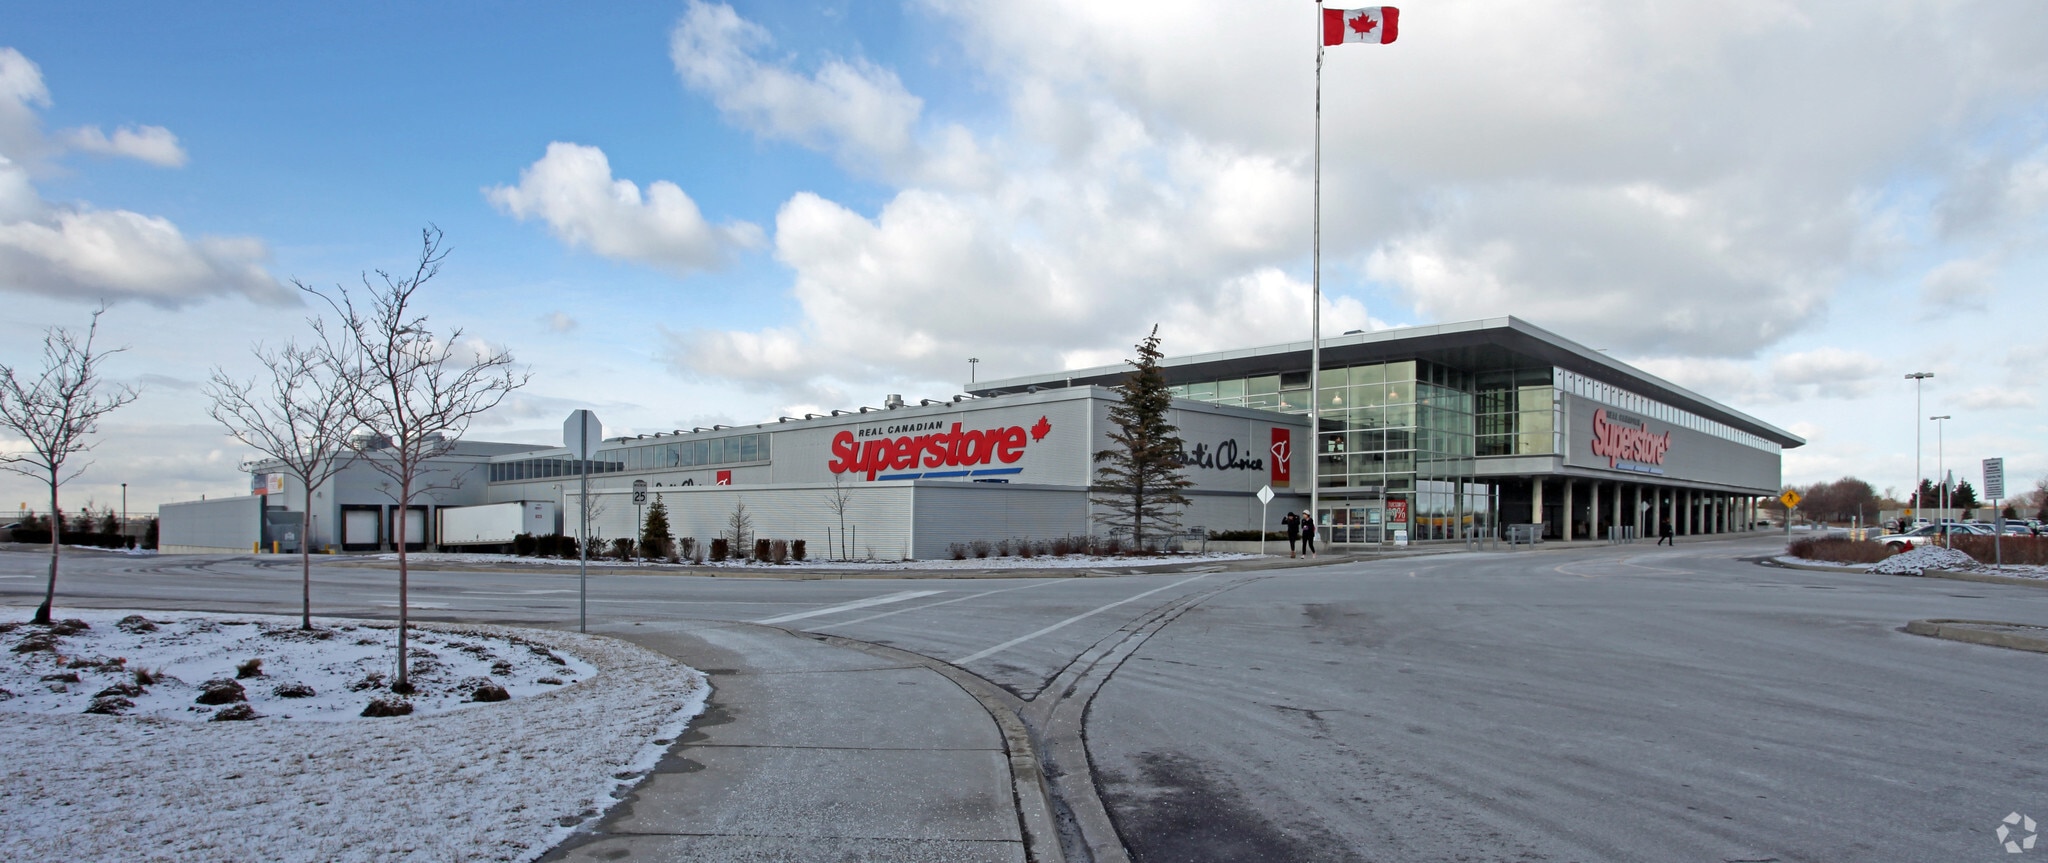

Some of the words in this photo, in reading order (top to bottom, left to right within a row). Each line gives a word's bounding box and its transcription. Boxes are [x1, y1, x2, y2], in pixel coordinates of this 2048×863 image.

[858, 427, 883, 437] REAL
[887, 421, 943, 434] CANADIAN
[1592, 408, 1665, 468] Superstore
[828, 422, 1027, 481] Superstore
[1216, 438, 1264, 470] Choice
[634, 491, 646, 502] 25
